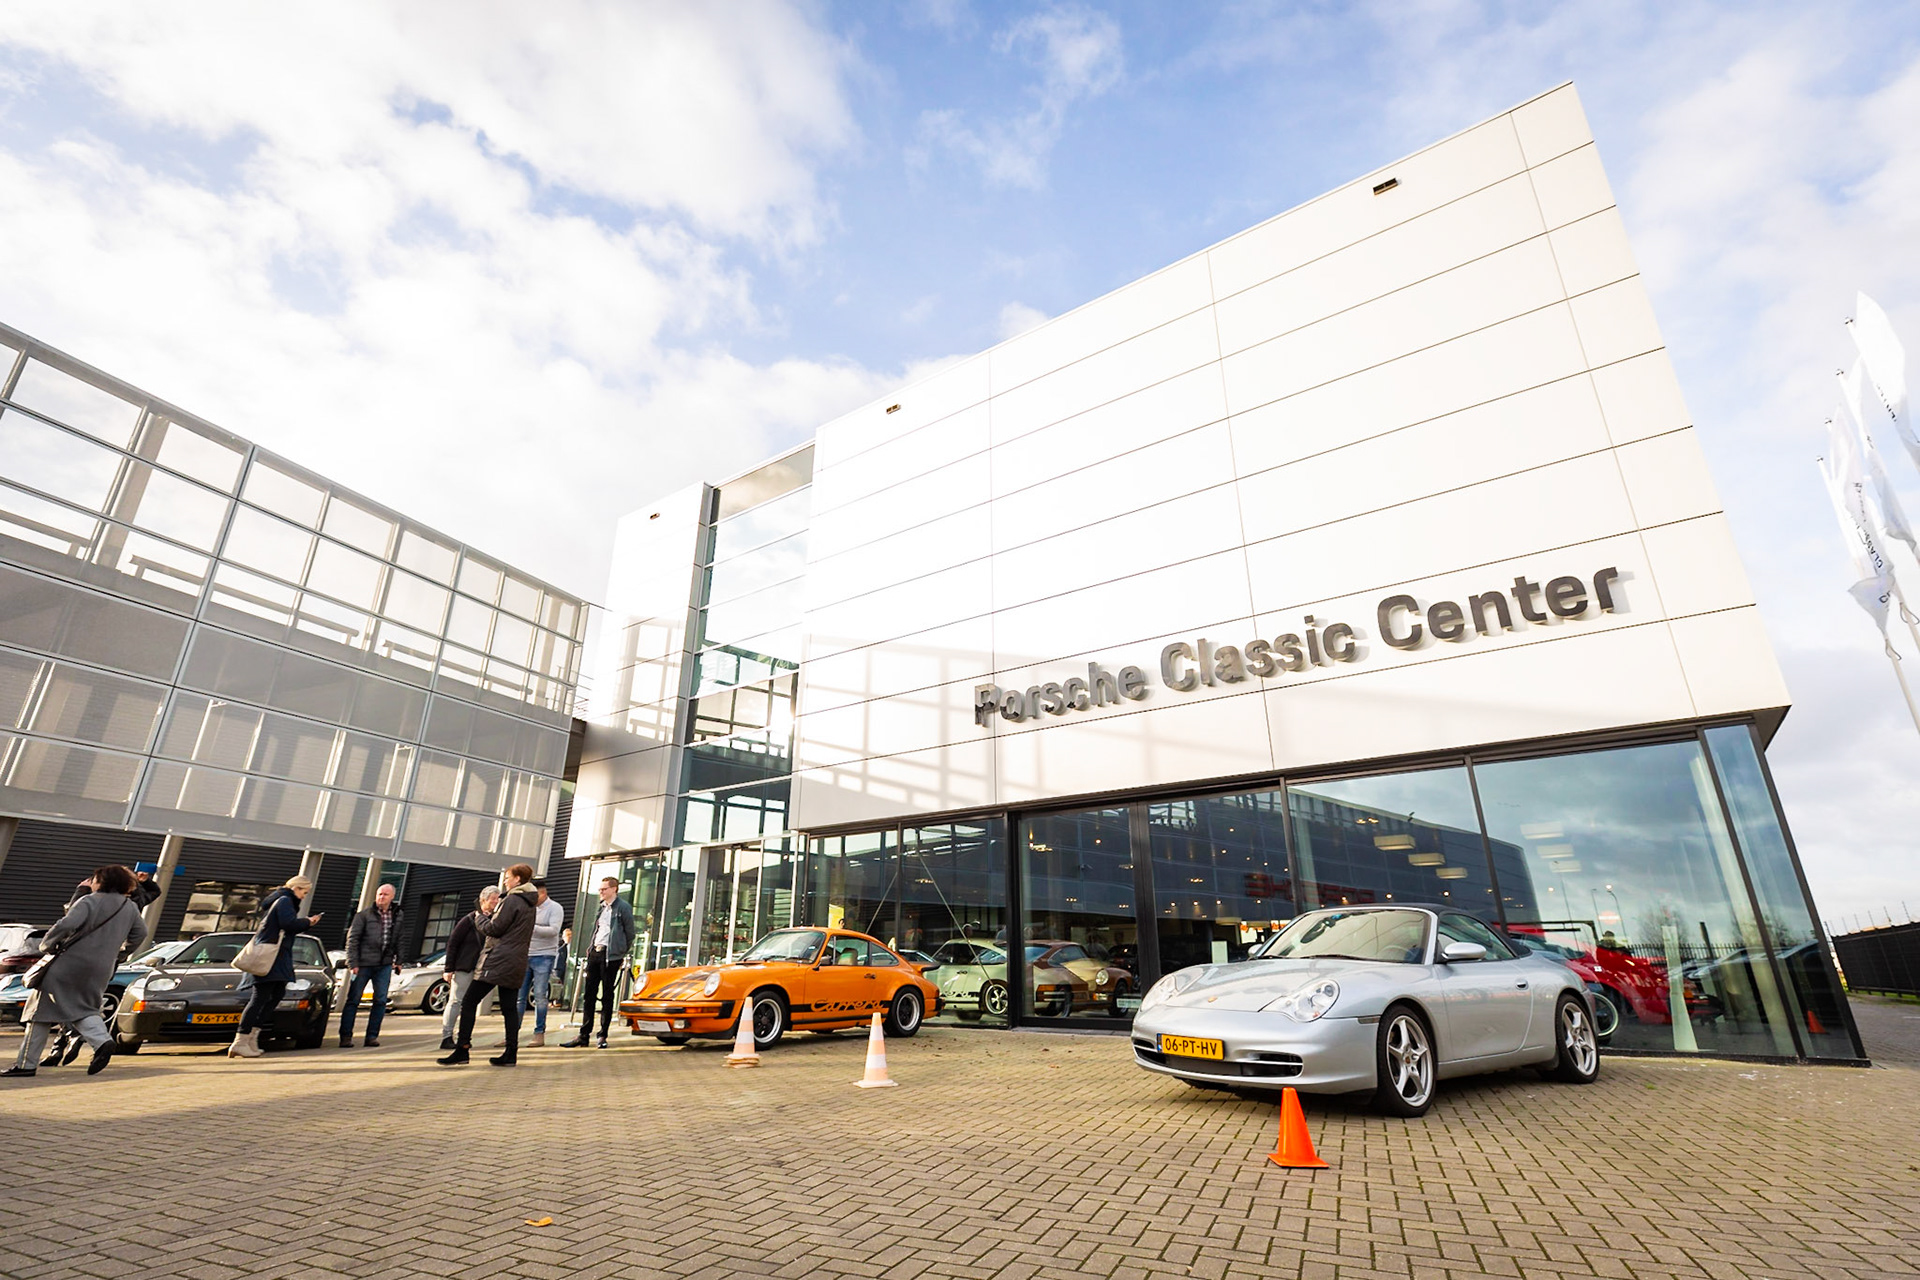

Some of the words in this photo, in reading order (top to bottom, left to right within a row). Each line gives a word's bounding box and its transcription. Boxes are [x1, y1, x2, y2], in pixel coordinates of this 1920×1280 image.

[974, 661, 1148, 728] Porsche
[1160, 614, 1357, 692] Classic
[1377, 566, 1620, 651] Center
[810, 998, 884, 1013] Carrera
[196, 1014, 242, 1023] 96-TX-K
[1165, 1038, 1217, 1056] 06-PT-HV
